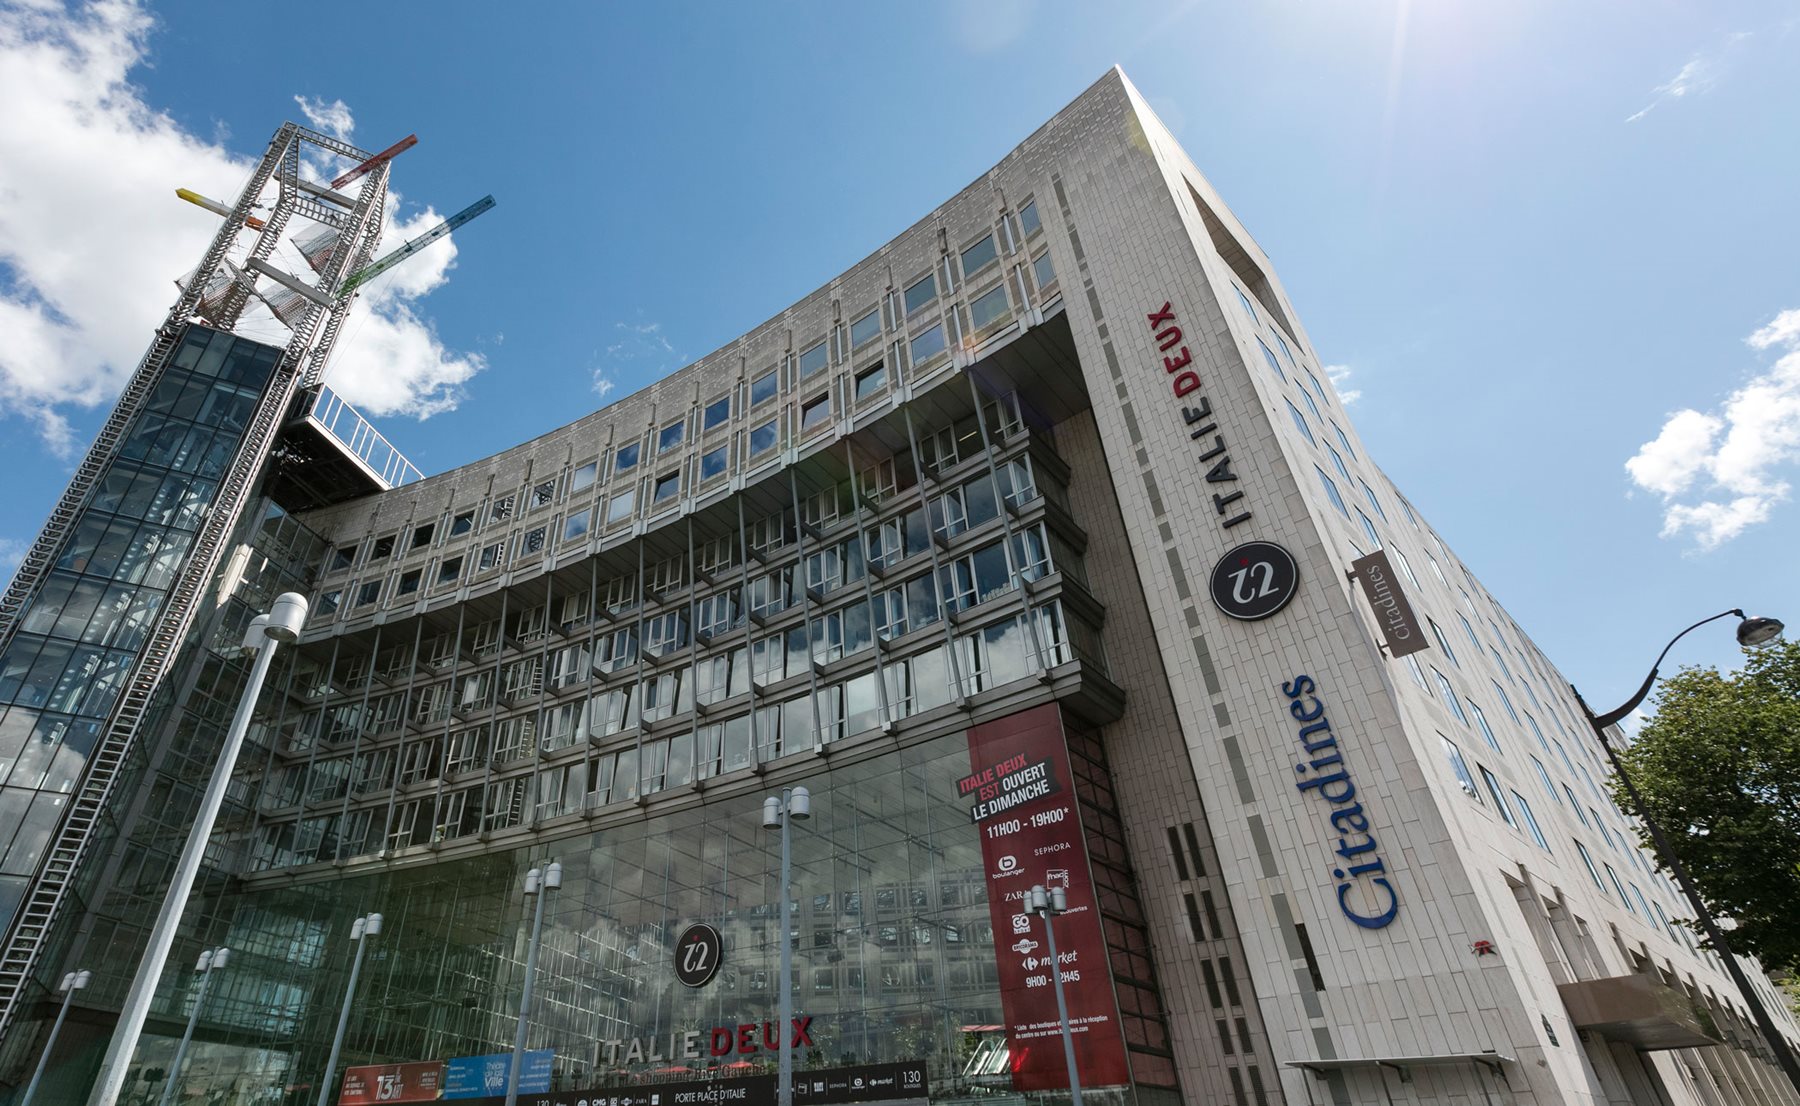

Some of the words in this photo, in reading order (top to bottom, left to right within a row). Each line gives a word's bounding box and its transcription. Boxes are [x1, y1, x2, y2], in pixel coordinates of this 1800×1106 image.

[1147, 301, 1202, 399] DEUX
[1181, 396, 1252, 530] ITALIE
[1366, 564, 1410, 641] citadines
[959, 770, 994, 794] ITALIE
[996, 753, 1027, 776] DEUX
[980, 783, 1000, 802] EST
[1002, 762, 1047, 792] OUVERT
[973, 805, 988, 821] LE
[989, 779, 1051, 815] DIMANCHE
[1282, 674, 1399, 930] Citadines
[987, 818, 1020, 839] 11H00
[1034, 842, 1071, 856] SEPHORA
[992, 868, 1025, 879] boulanger
[1004, 890, 1026, 902] ZAR
[1041, 950, 1078, 966] mrket
[1026, 975, 1047, 988] 9H00
[592, 1030, 702, 1068] ITALIE
[710, 1016, 813, 1057] DEUX
[376, 1075, 394, 1100] 13
[484, 1076, 504, 1087] Ville
[903, 1070, 921, 1083] 130
[675, 1092, 696, 1103] PORTE
[697, 1089, 718, 1101] PLACE
[720, 1087, 747, 1100] D'ITALIE
